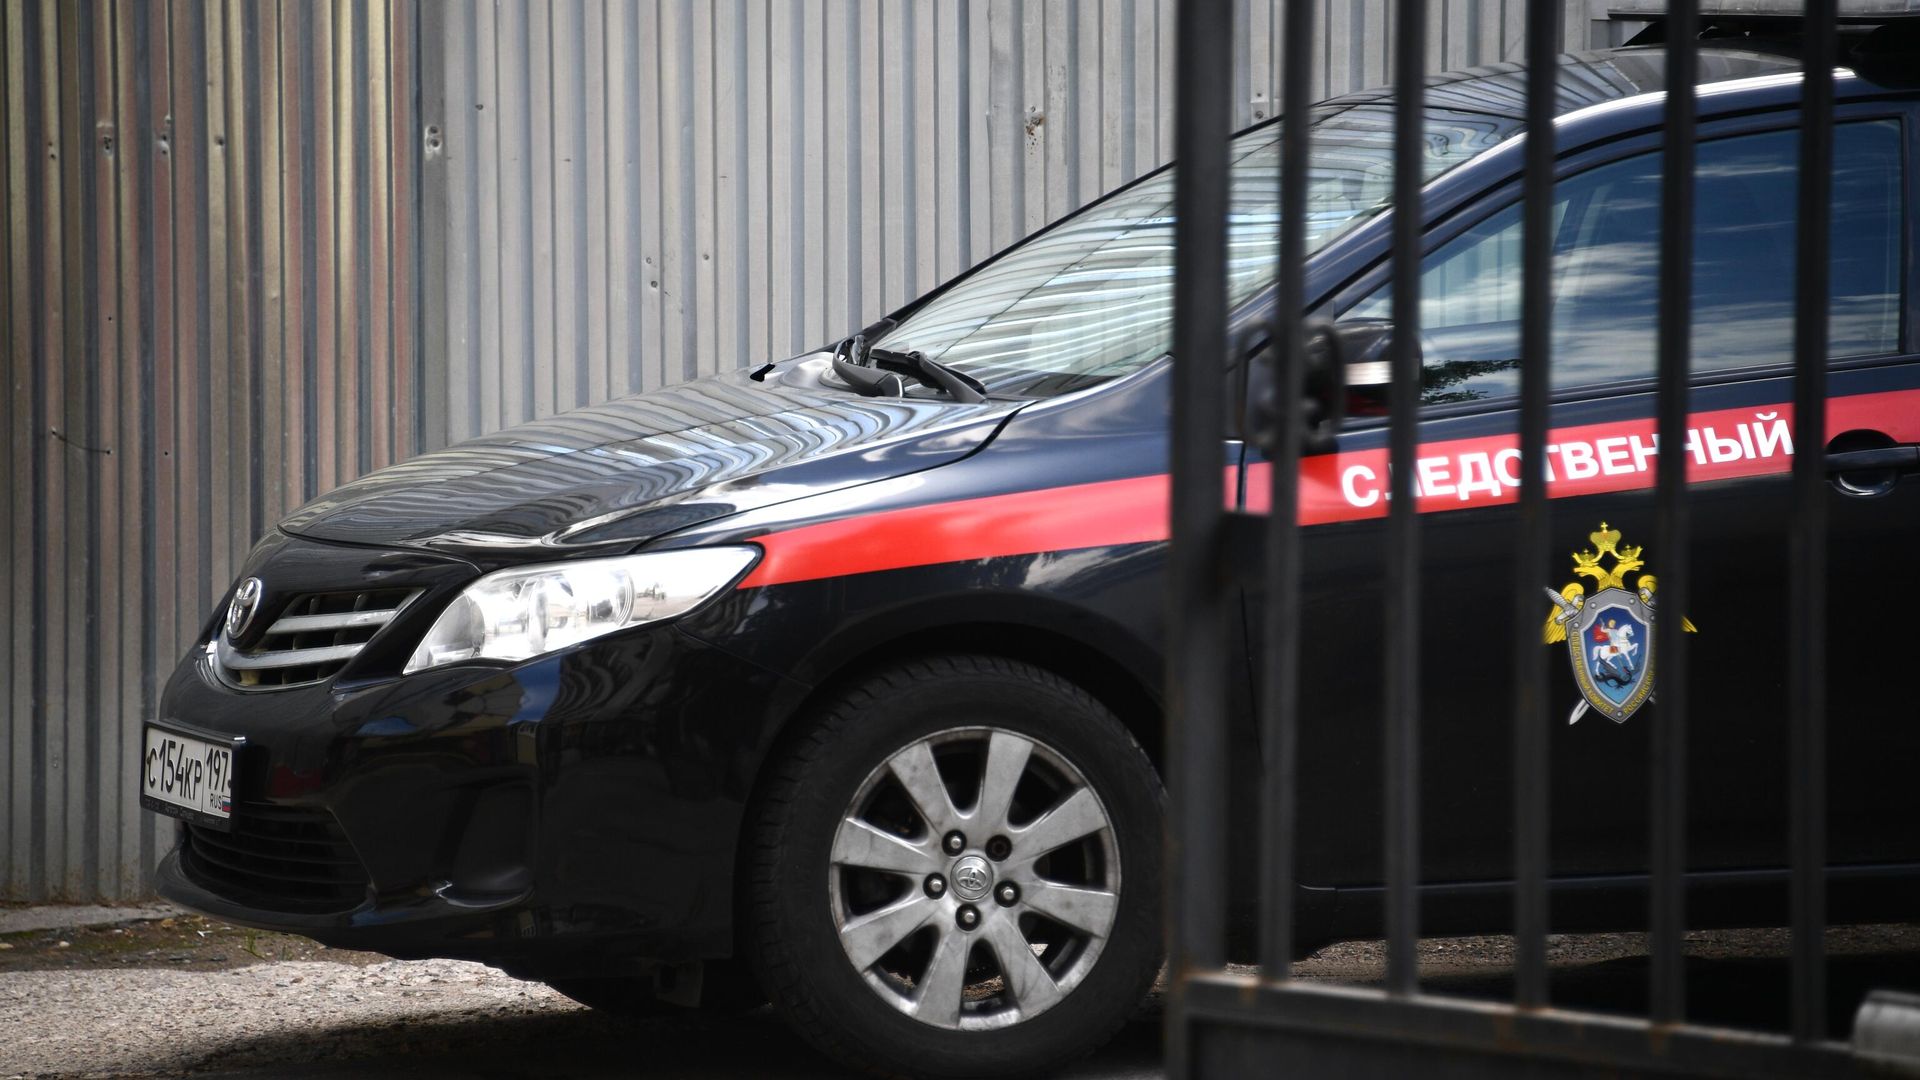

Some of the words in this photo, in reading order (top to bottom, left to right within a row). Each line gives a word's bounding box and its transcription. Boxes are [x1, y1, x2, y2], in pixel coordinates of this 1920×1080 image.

[1341, 411, 1794, 507] СЕДСТВЕННЫЙ
[206, 747, 228, 793] 197
[209, 793, 222, 811] RUS
